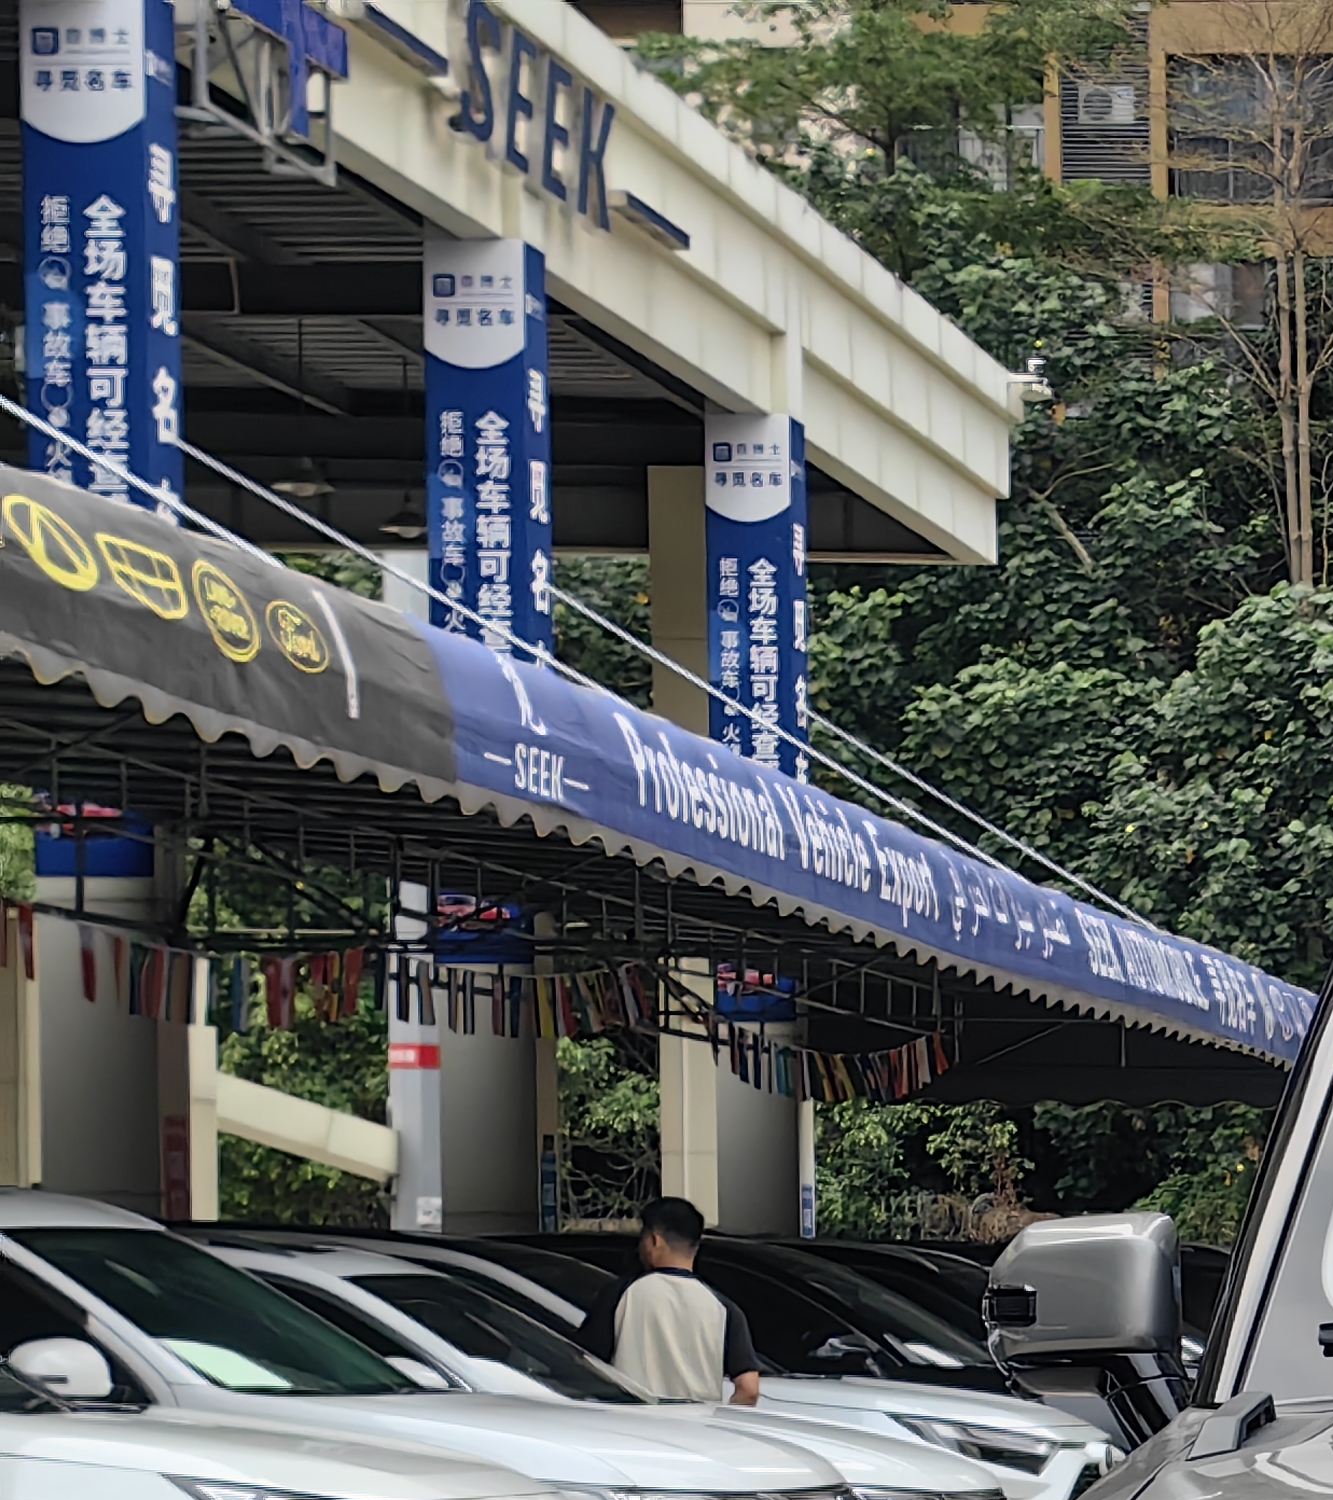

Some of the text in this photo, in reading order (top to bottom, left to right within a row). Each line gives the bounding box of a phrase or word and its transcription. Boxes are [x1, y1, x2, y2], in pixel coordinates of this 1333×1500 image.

[460, 0, 615, 233] SEEK
[514, 742, 566, 803] SEEK
[613, 711, 786, 861] Professional
[772, 781, 872, 893] Vehicle
[861, 819, 941, 929] Export
